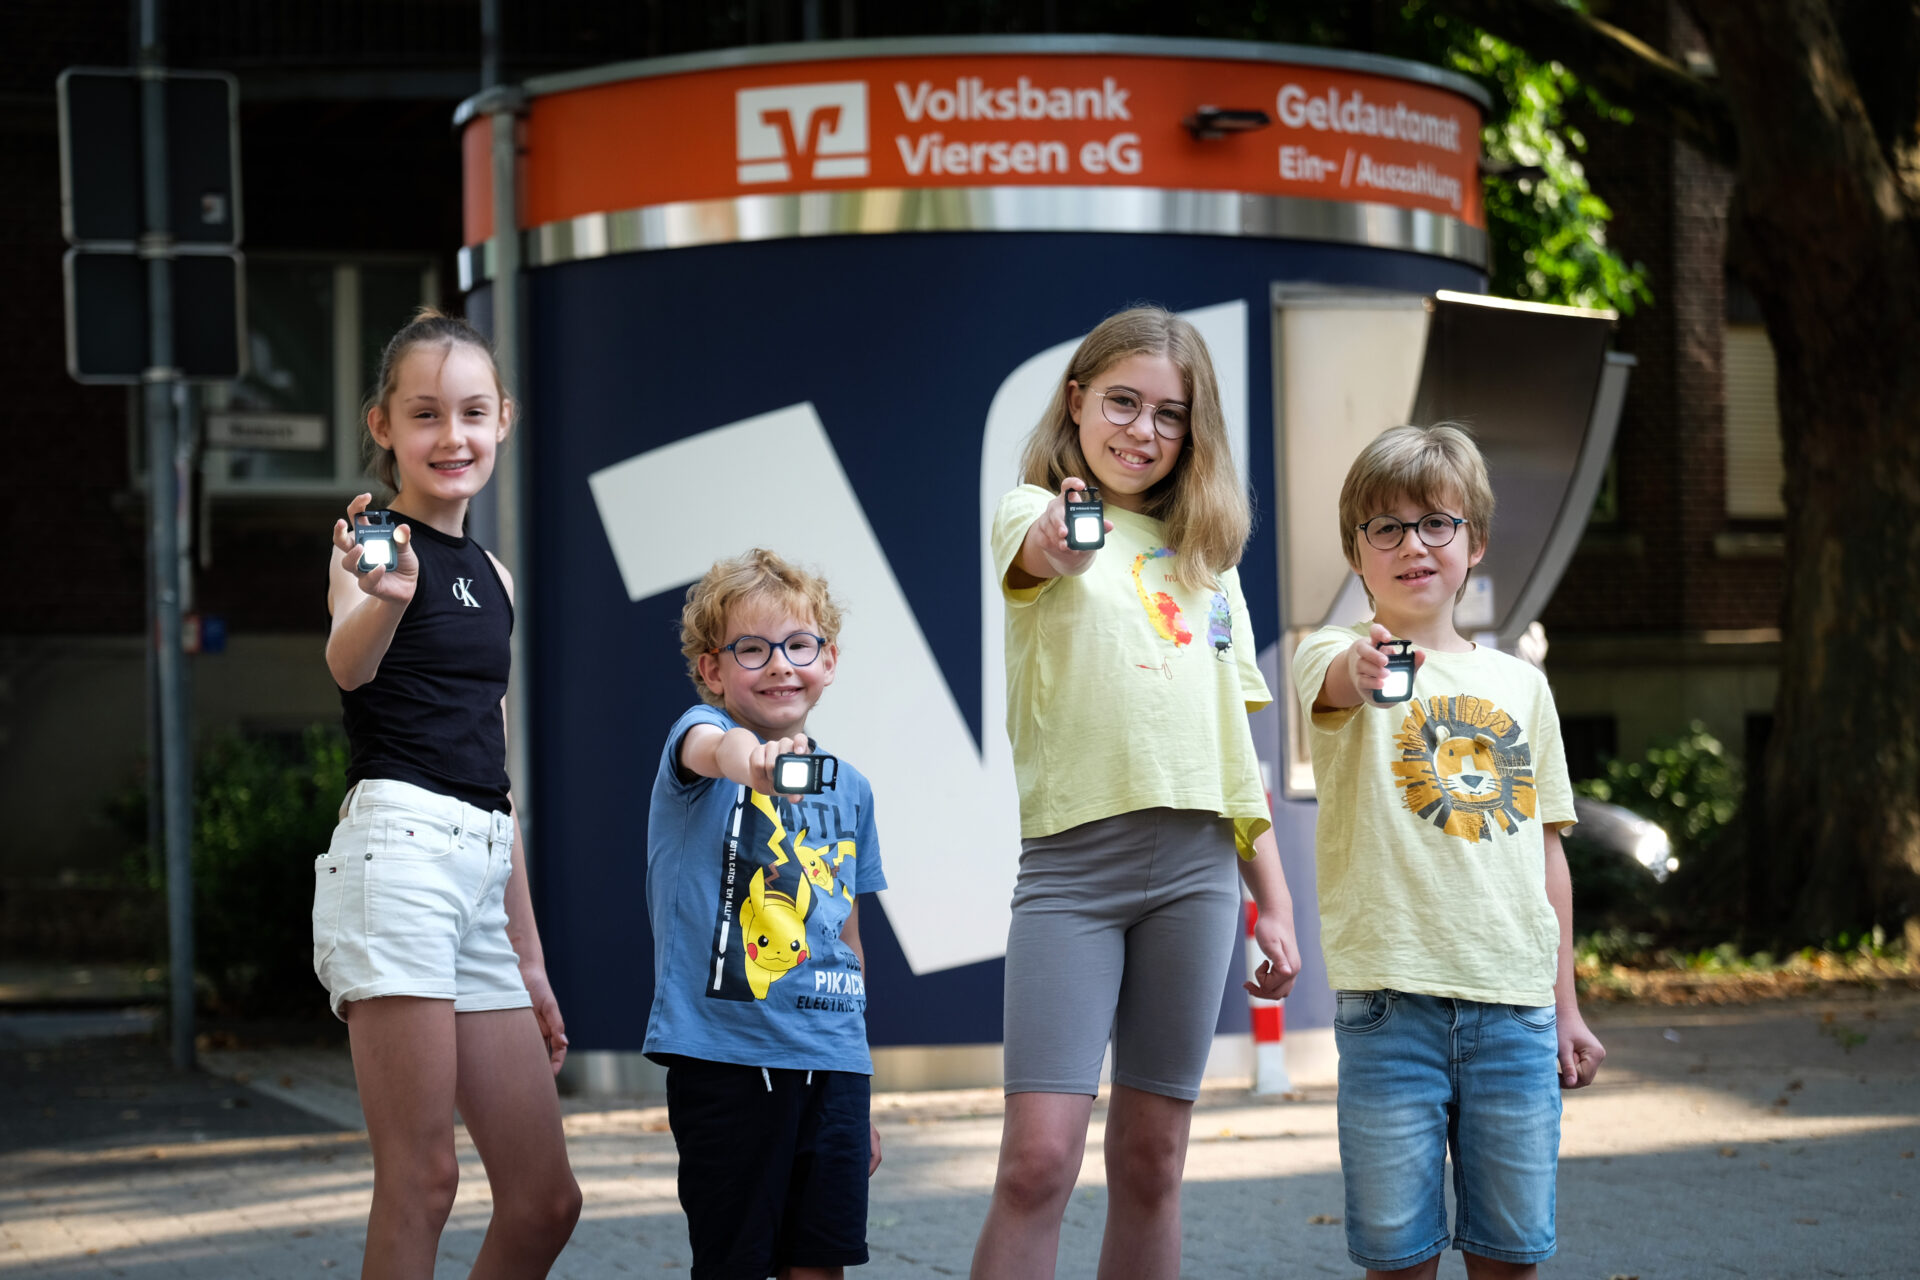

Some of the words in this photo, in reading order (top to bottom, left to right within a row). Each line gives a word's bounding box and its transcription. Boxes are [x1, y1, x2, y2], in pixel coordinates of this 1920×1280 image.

[895, 77, 1131, 122] Volksbank
[1277, 84, 1461, 154] Geldautomat
[895, 132, 1070, 176] Viersen
[1079, 133, 1142, 175] eG
[1278, 146, 1338, 182] Ein-
[1356, 154, 1462, 211] Auszahlung
[727, 862, 736, 884] CATCH
[796, 995, 855, 1013] ELECTRIC
